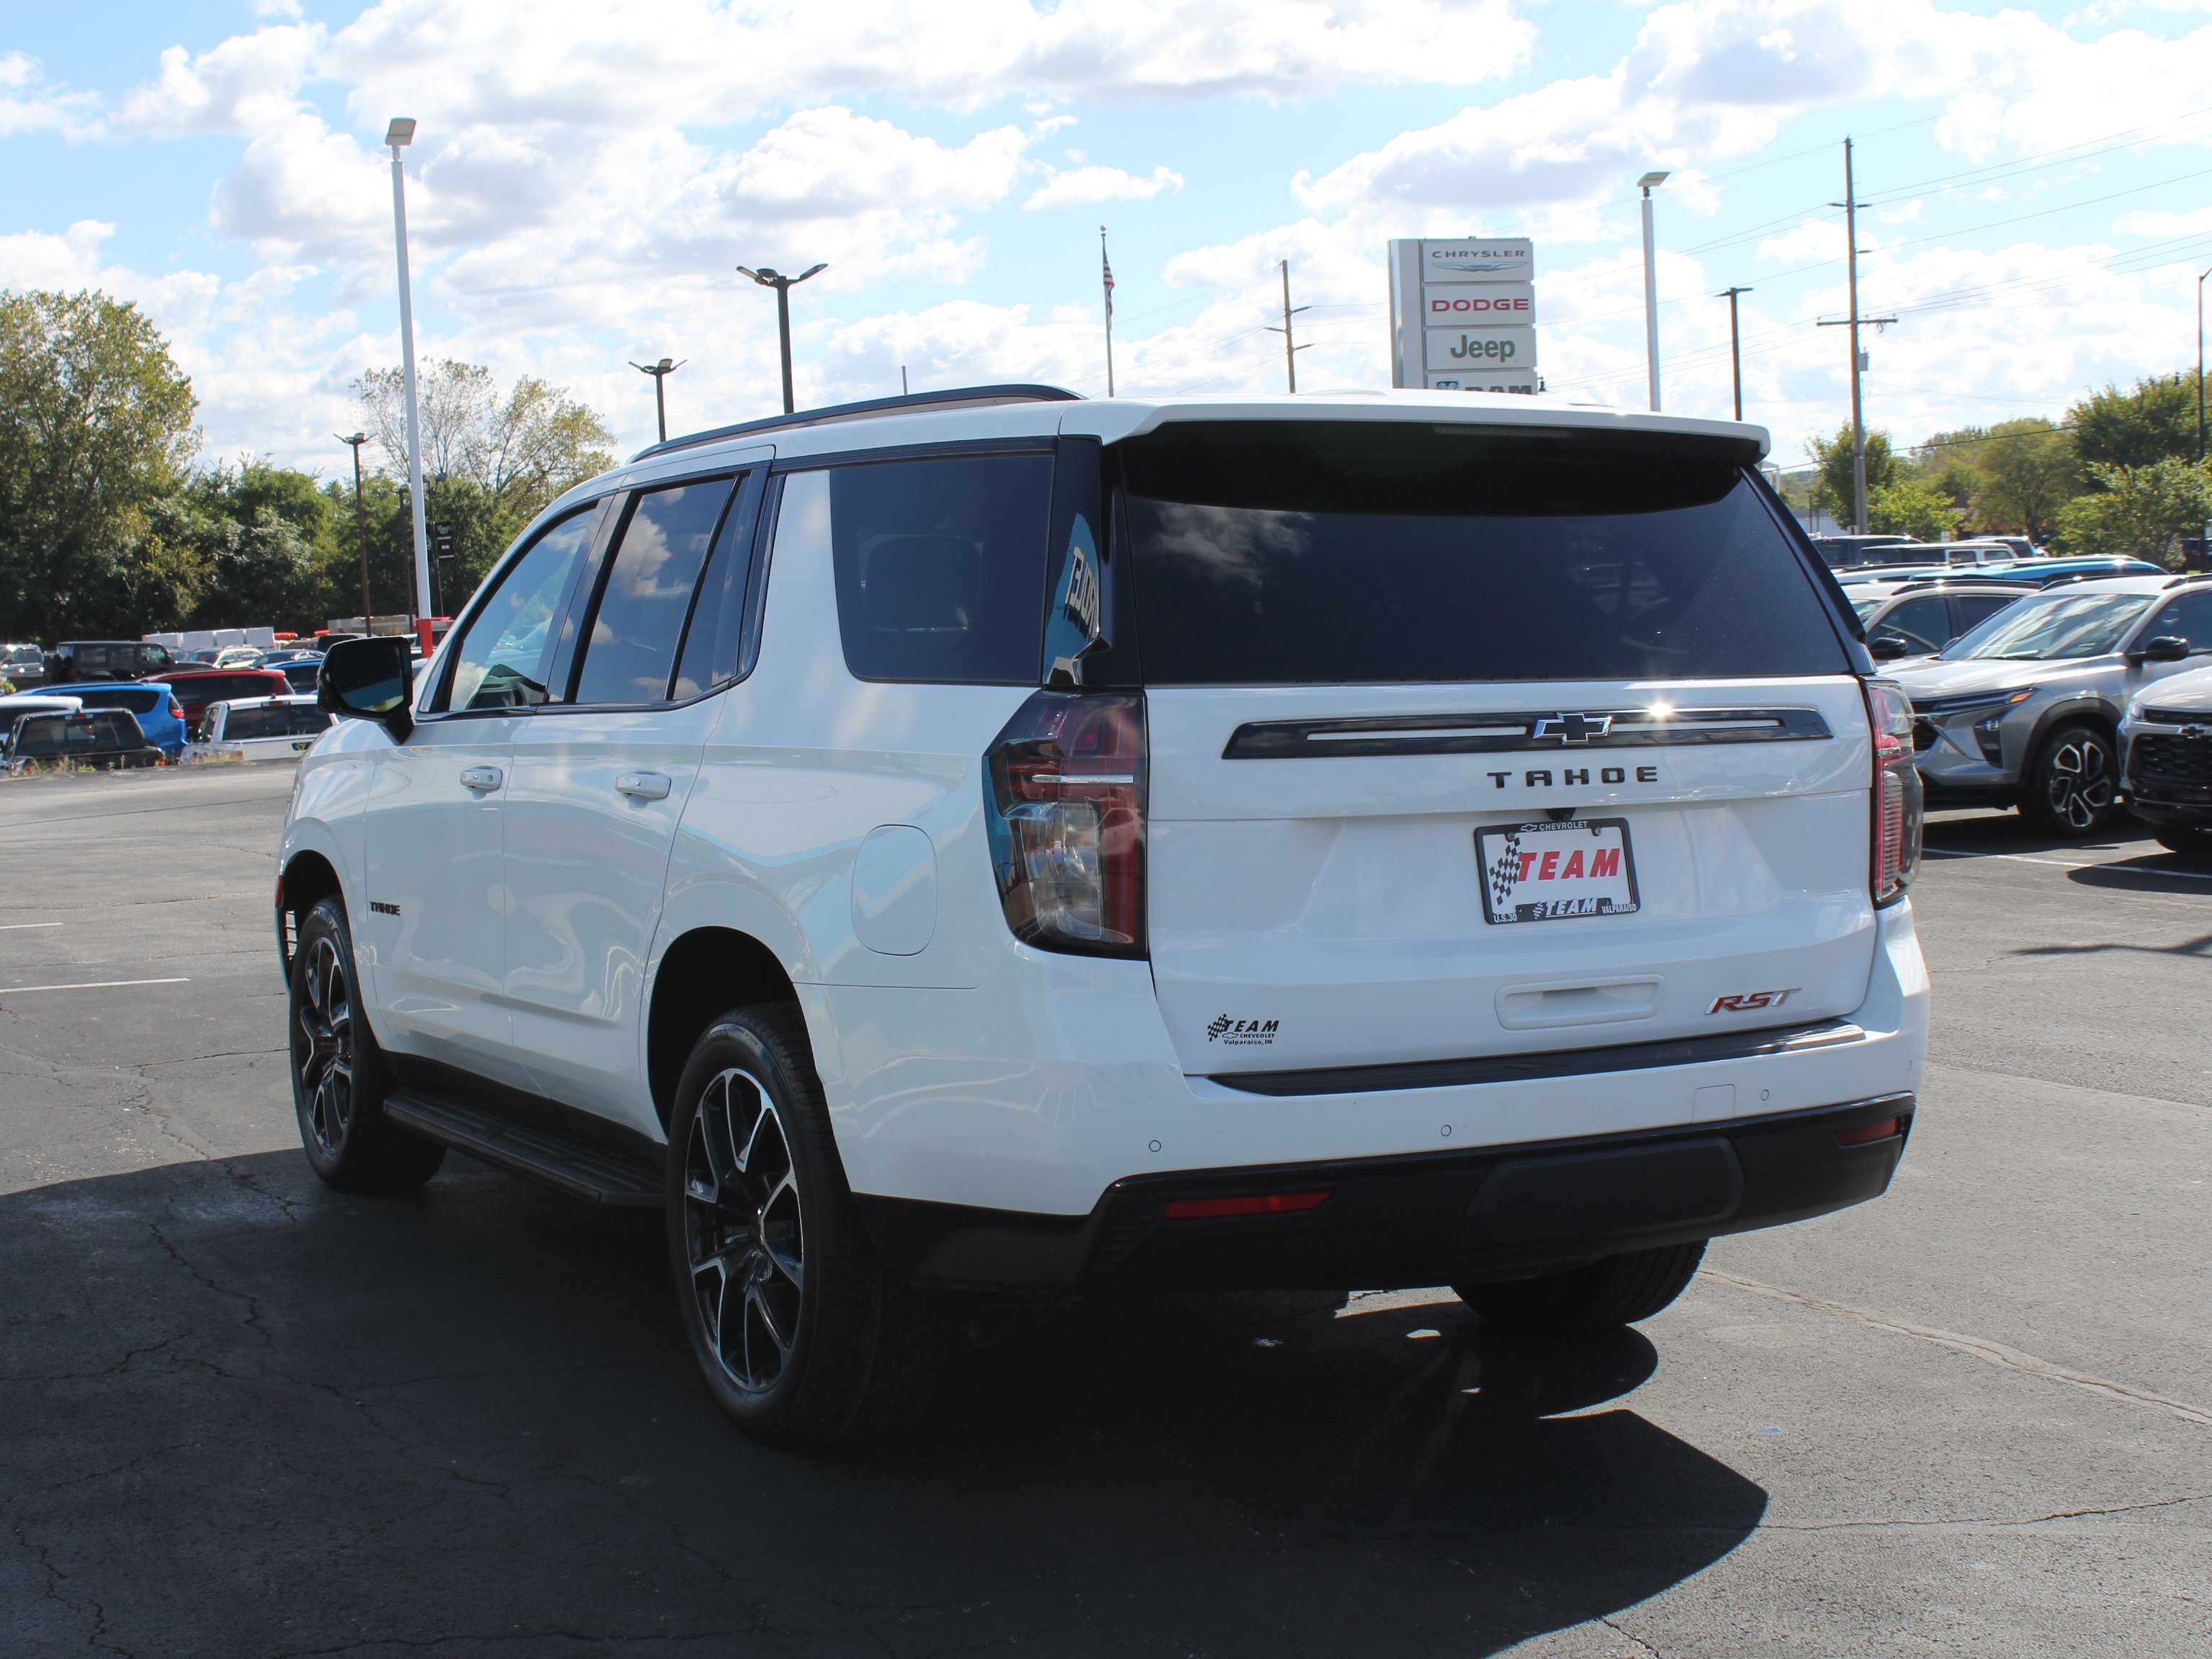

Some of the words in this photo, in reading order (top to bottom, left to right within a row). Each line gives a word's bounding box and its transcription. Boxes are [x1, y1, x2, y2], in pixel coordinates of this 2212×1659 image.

[1431, 250, 1525, 258] CHRYSLER
[1431, 299, 1529, 312] DODGE
[1449, 334, 1516, 362] Jeep
[1487, 766, 1658, 788] TAHOE
[1539, 821, 1588, 832] CHEVROLET
[1517, 848, 1620, 882] TEAM
[1545, 897, 1598, 916] TEAM
[1601, 903, 1637, 914] VALPARAISO
[1704, 987, 1802, 1015] RST
[1223, 1020, 1280, 1032] TEAM
